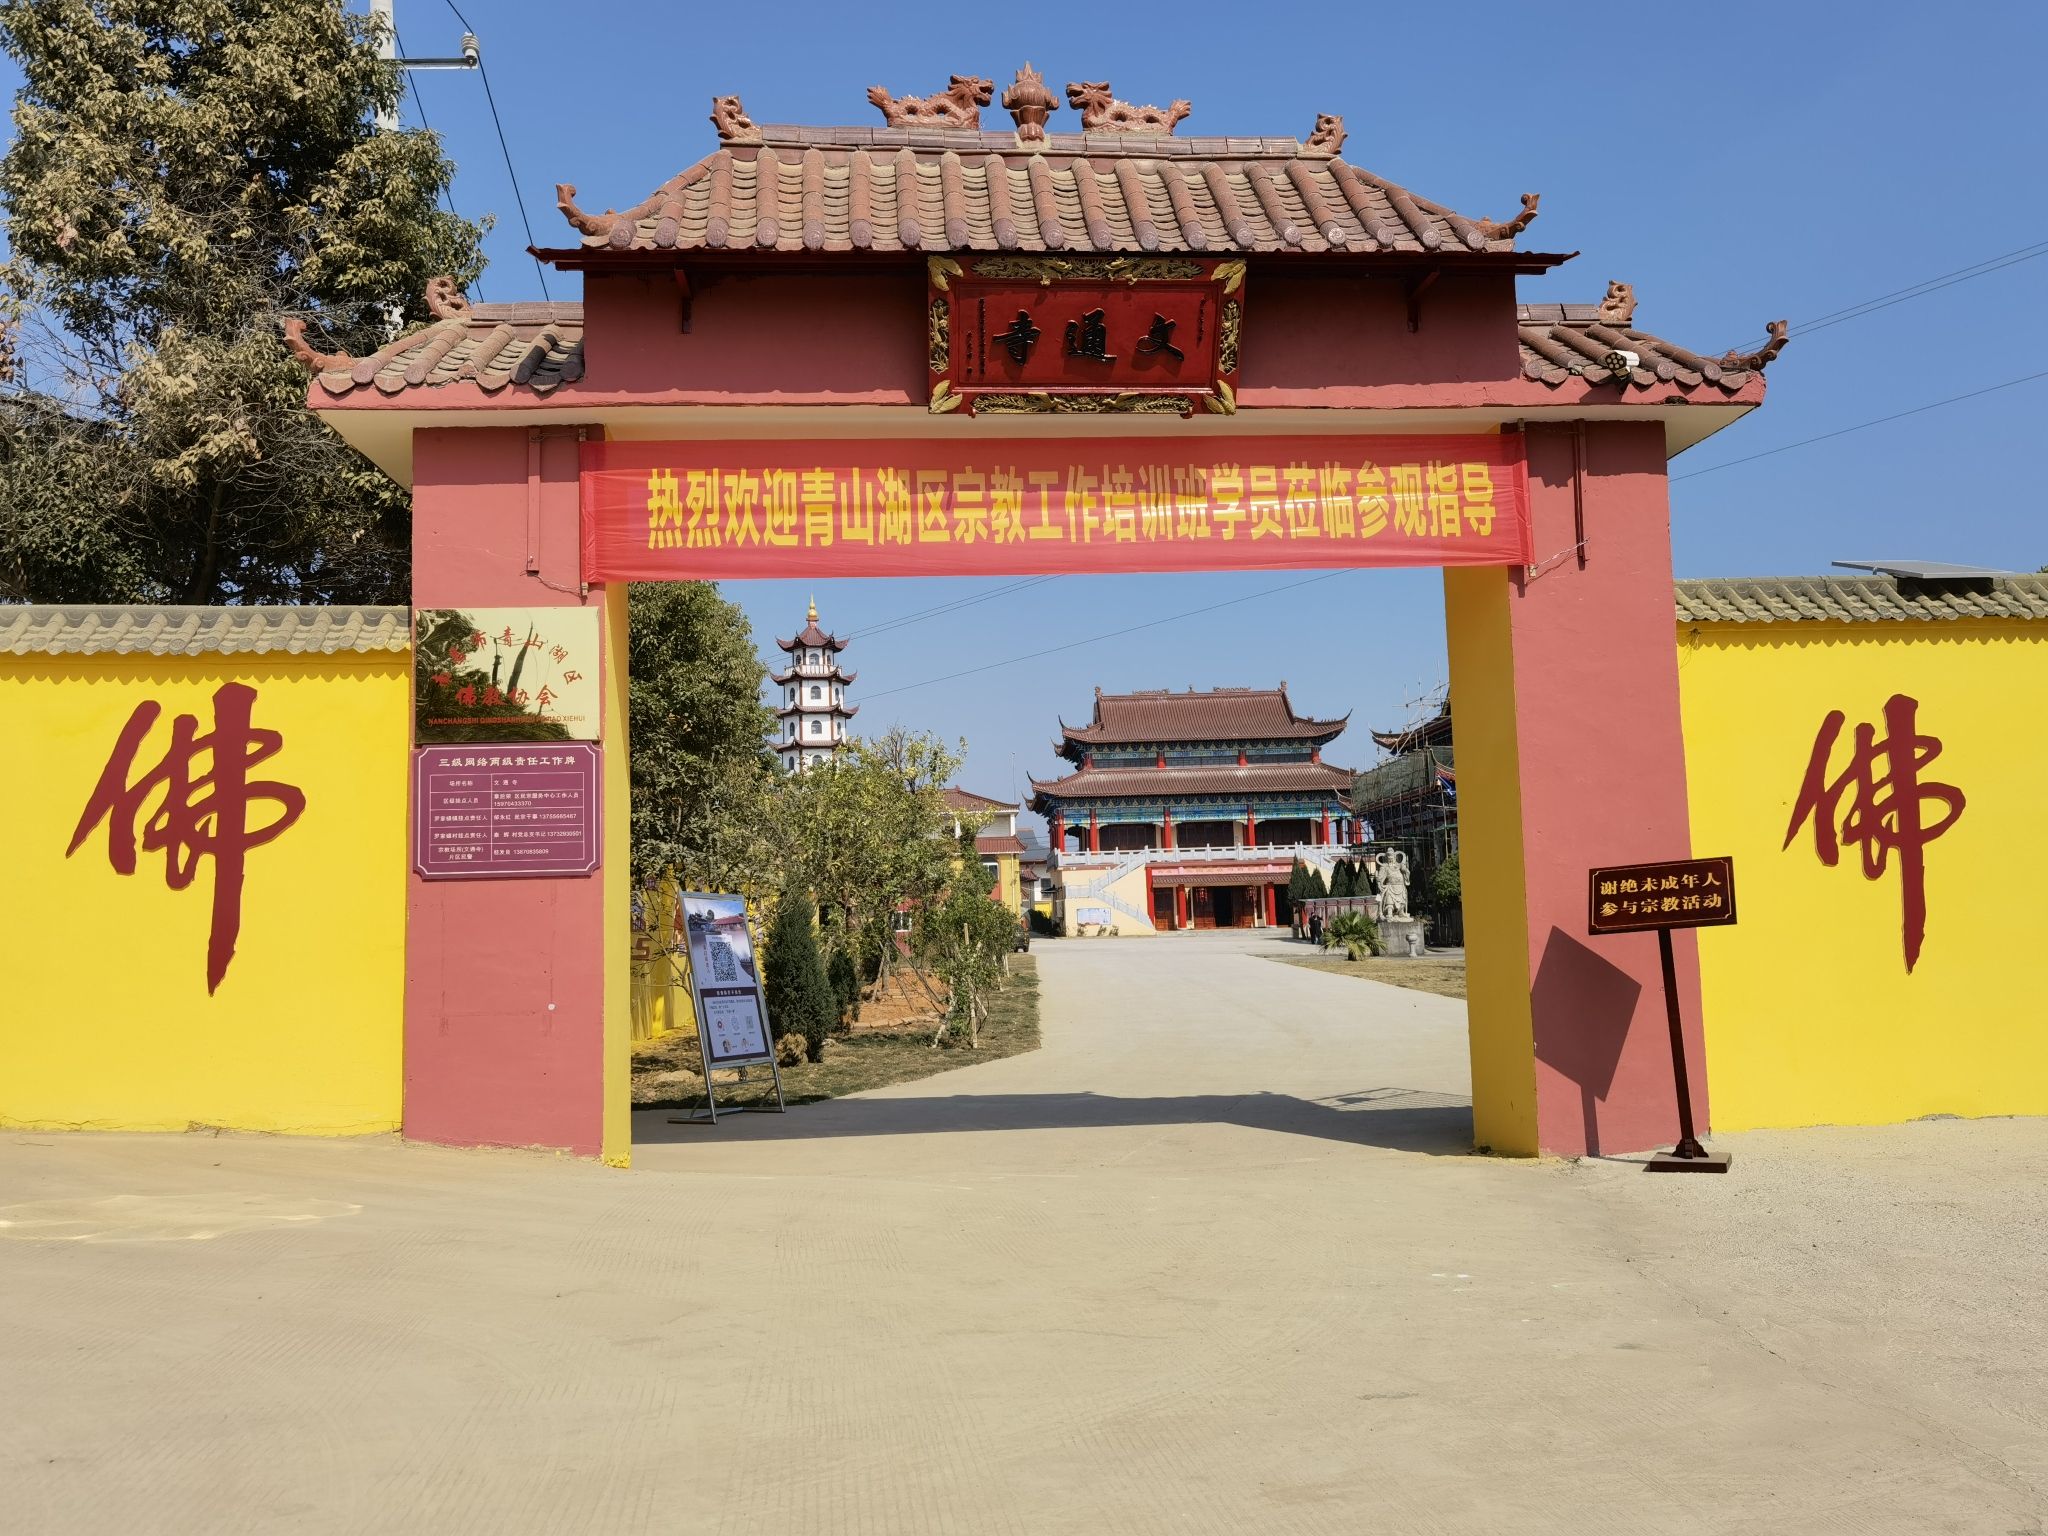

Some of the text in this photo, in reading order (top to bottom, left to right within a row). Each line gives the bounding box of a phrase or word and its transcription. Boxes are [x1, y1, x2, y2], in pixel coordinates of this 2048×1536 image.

[647, 460, 1497, 550] 热烈欢迎青山湖区宗教工作培训班学员莅临参观指导
[438, 755, 576, 767] 三级网络两级责任工作牌
[65, 681, 307, 998] 佛
[1781, 693, 1967, 976] 佛
[1600, 872, 1722, 896] 谢绝未成年人
[1600, 893, 1722, 917] 参与宗教活动
